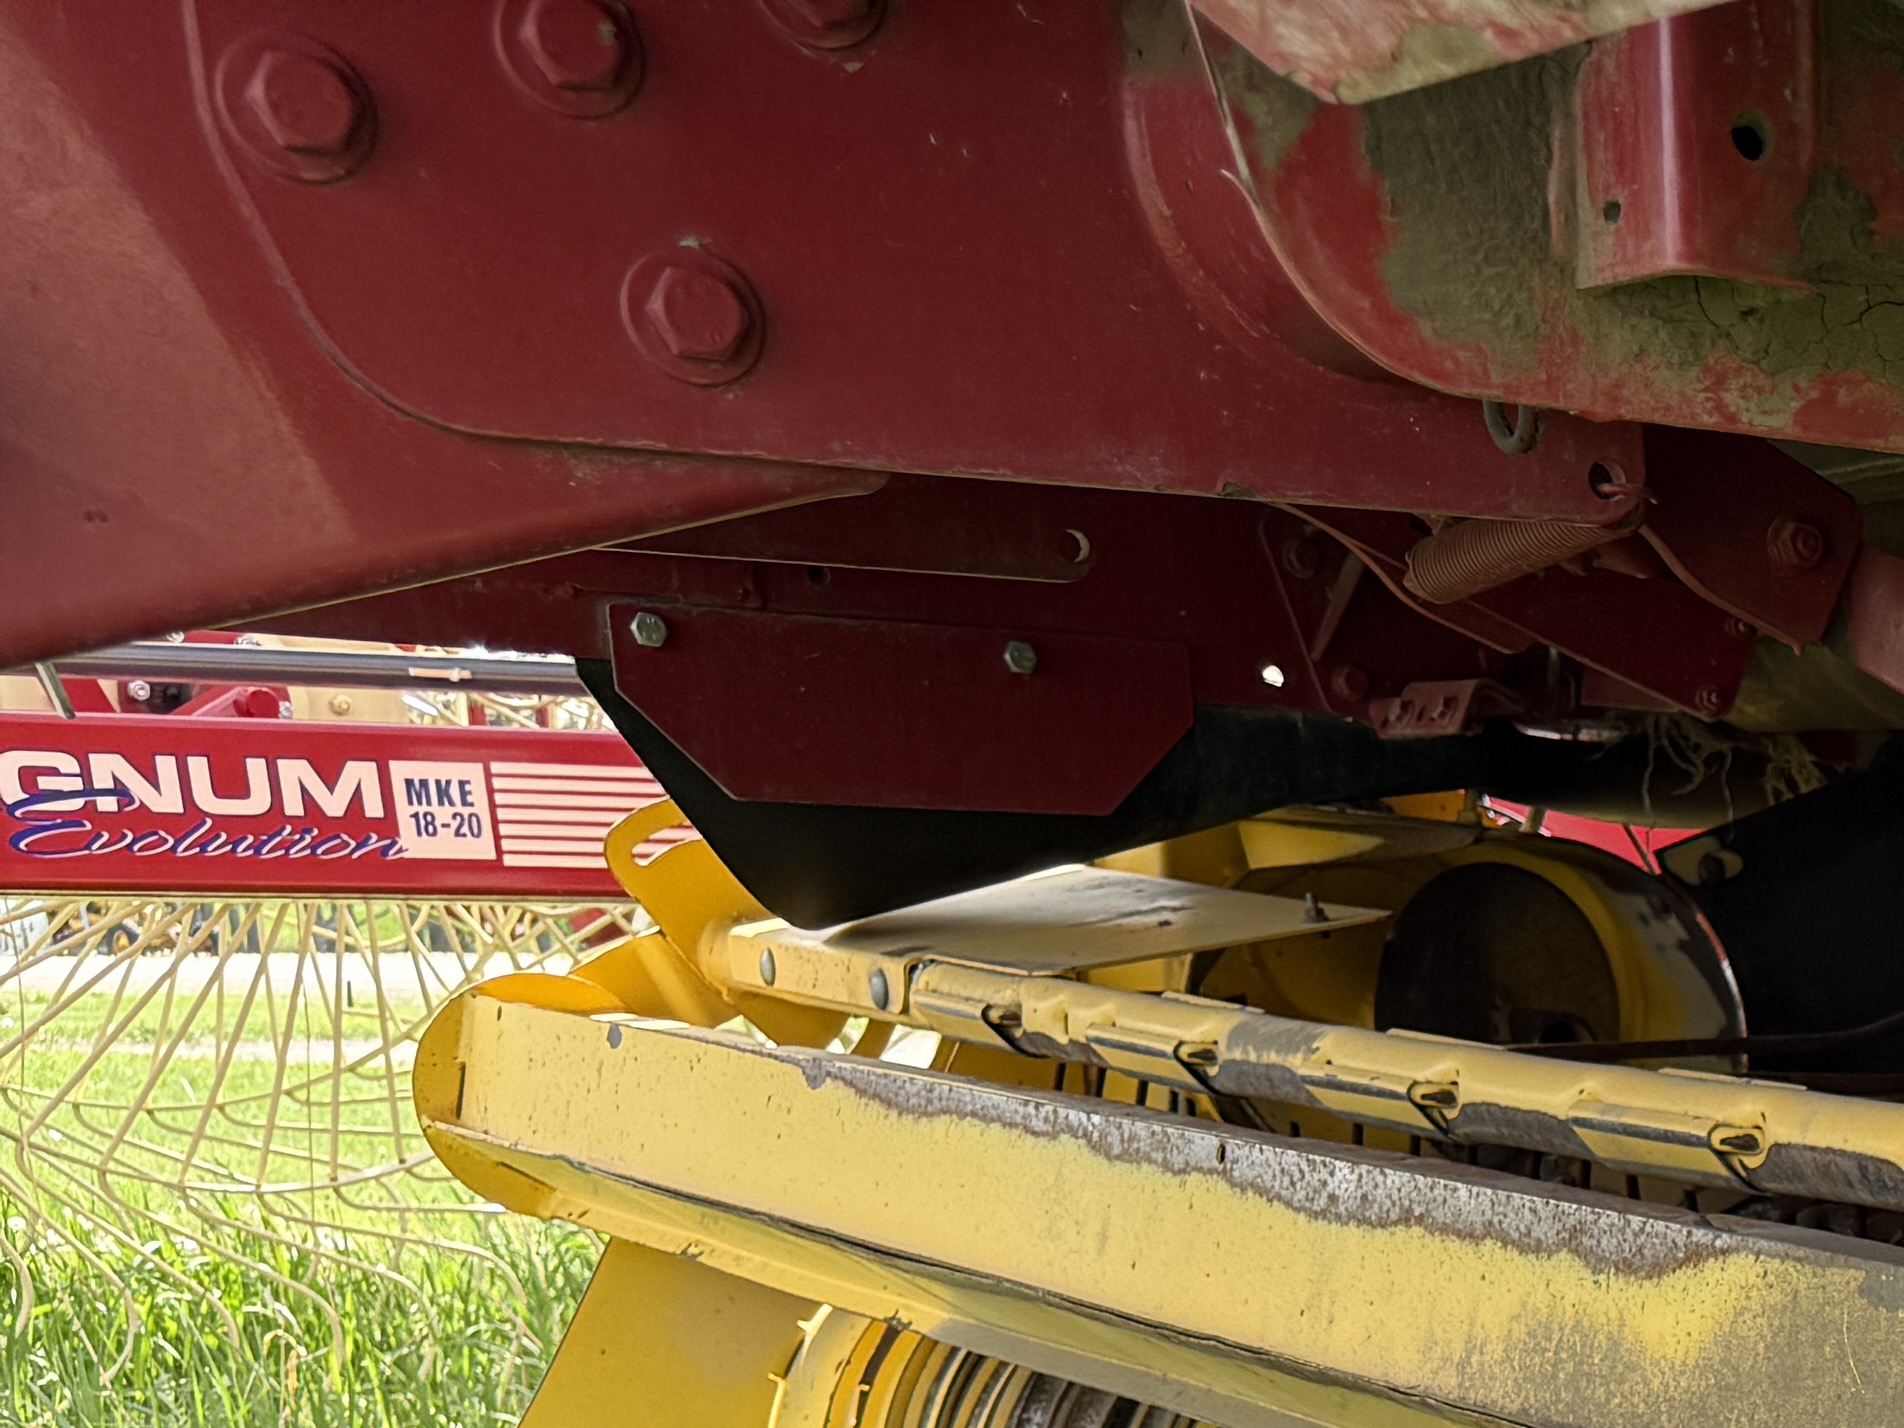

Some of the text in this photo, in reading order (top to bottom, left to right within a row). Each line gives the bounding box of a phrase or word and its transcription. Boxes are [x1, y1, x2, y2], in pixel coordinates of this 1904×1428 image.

[403, 778, 476, 808] MKE
[7, 788, 410, 860] Evolution
[409, 810, 483, 840] 18-20
